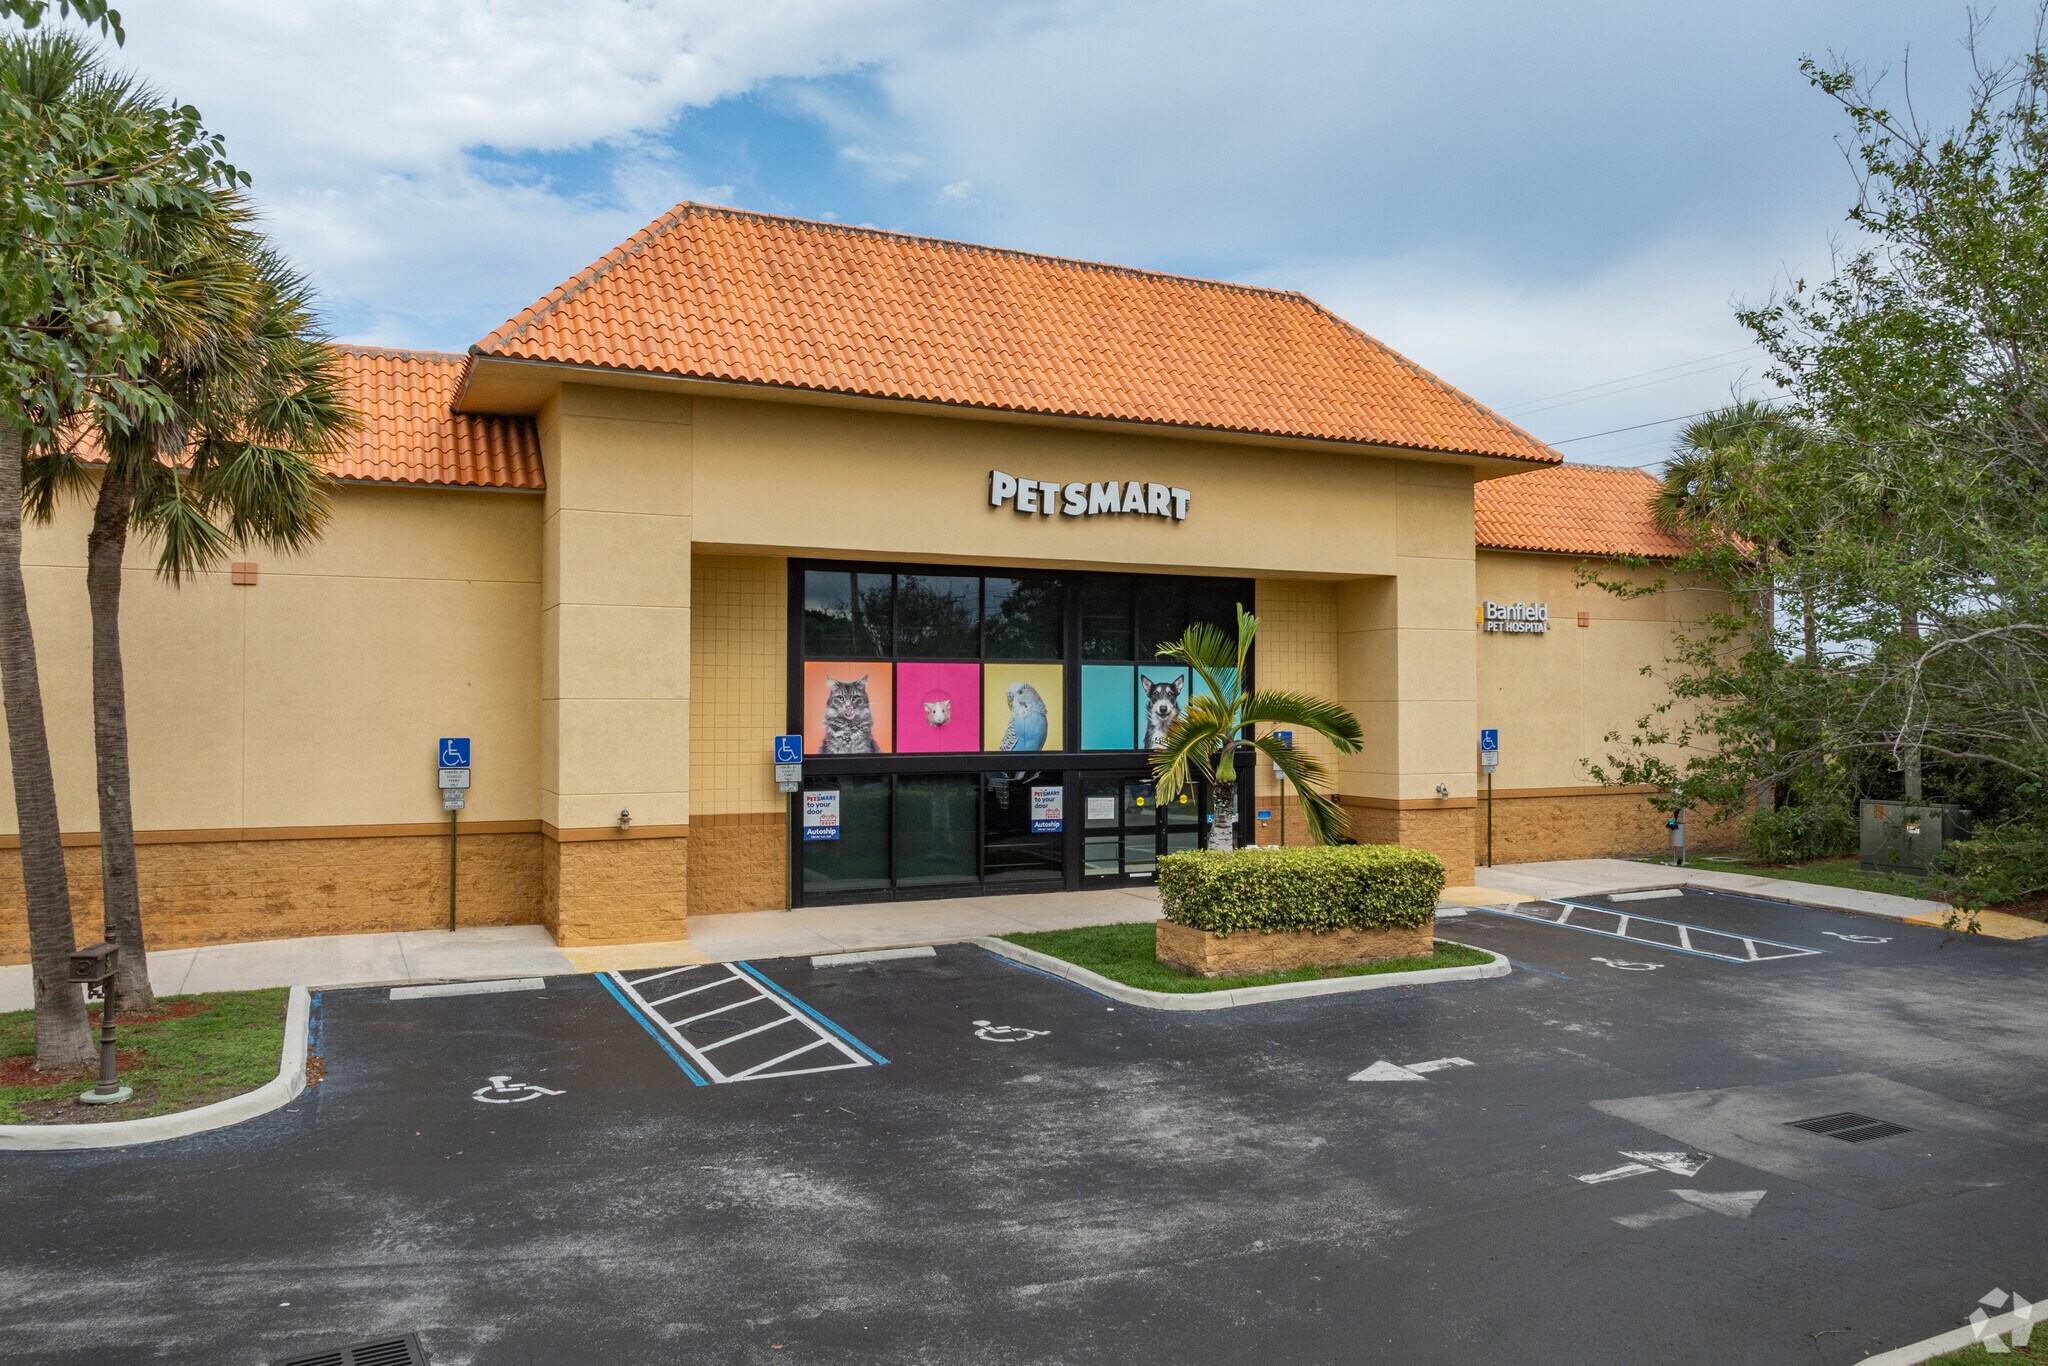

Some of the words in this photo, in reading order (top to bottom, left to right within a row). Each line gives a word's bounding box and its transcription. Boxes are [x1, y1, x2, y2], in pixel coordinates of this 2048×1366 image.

[989, 469, 1191, 521] PETSMART
[1484, 601, 1549, 621] Banfield
[1487, 621, 1504, 632] PET
[1505, 622, 1549, 633] HOSPITAL
